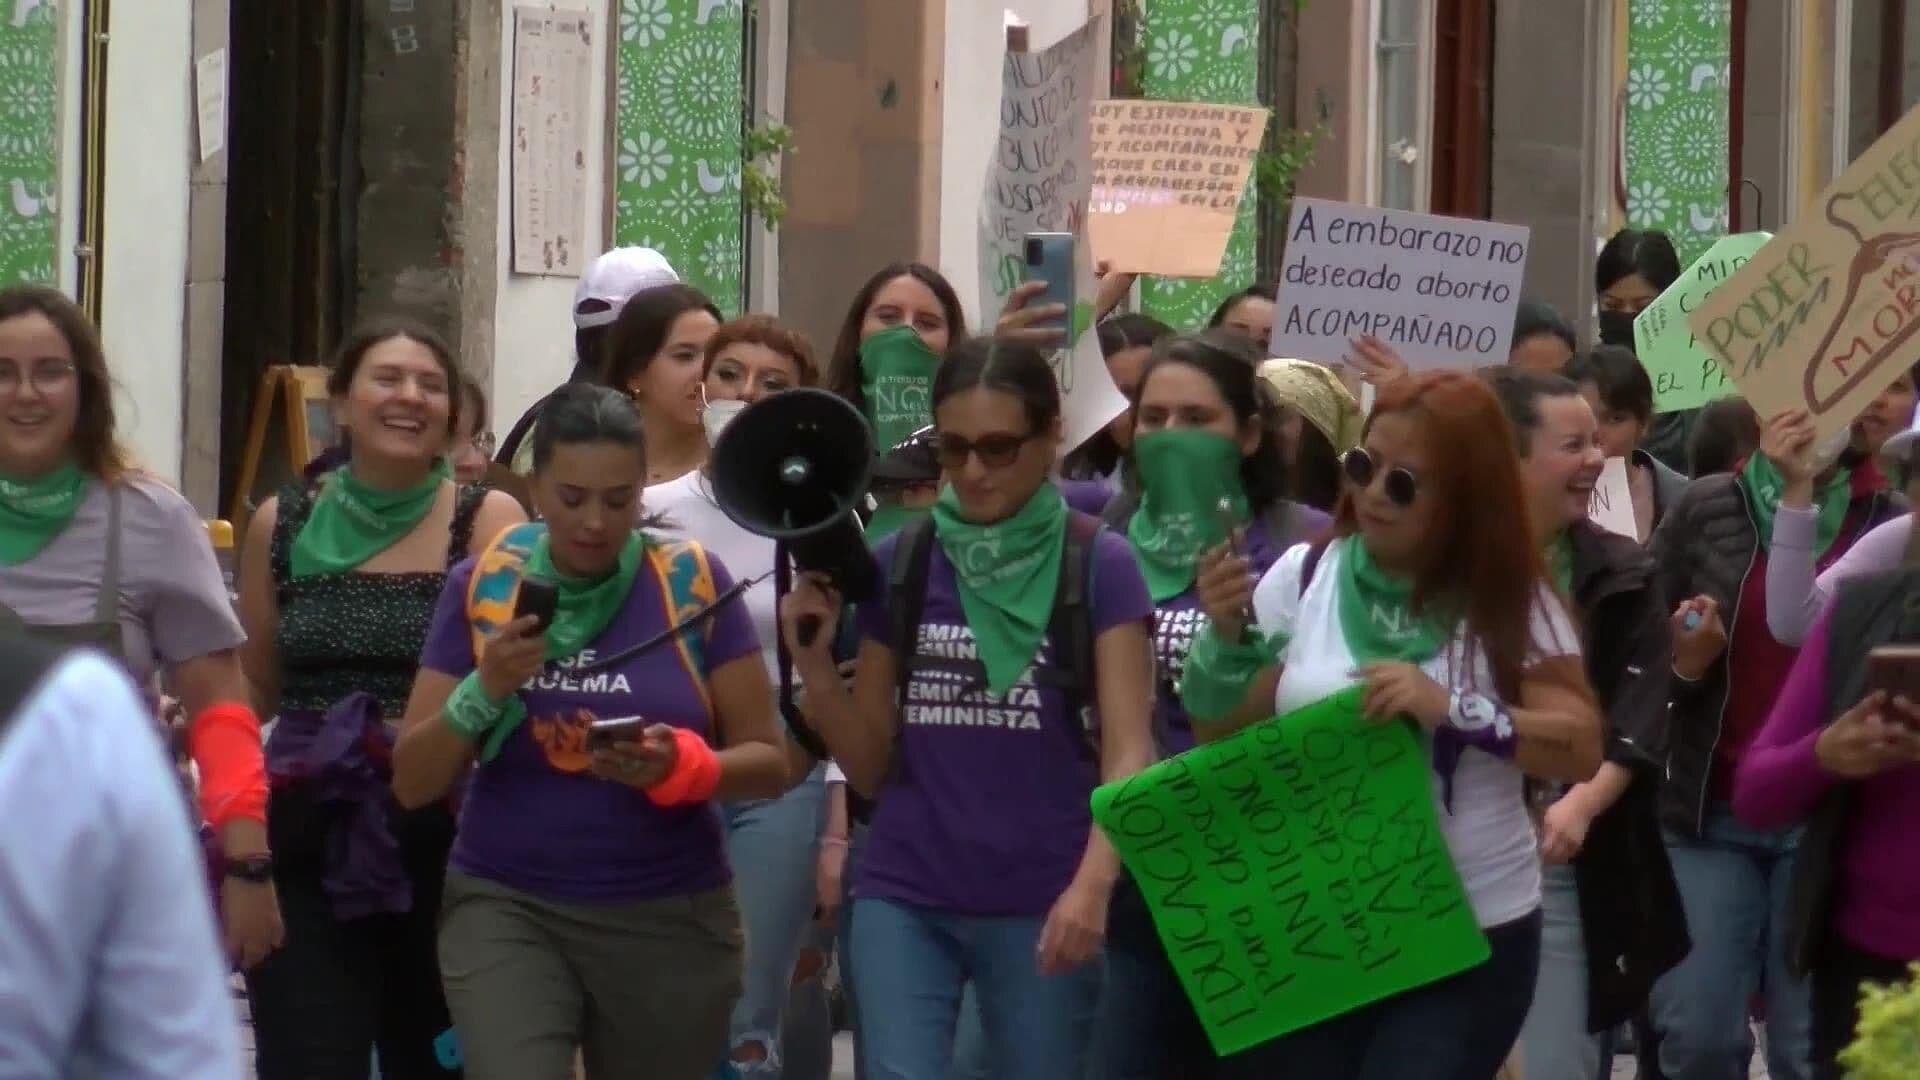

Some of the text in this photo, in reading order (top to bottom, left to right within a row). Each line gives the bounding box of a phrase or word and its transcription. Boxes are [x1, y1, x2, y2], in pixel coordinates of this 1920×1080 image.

[1118, 124, 1222, 140] MEDICINA
[1236, 128, 1249, 143] Y
[1292, 205, 1524, 264] A embarazo no
[1285, 255, 1510, 304] deseado aborto
[1706, 241, 1835, 367] PODER
[1284, 303, 1497, 353] ACOMPAÑADO
[1656, 372, 1683, 394] EL
